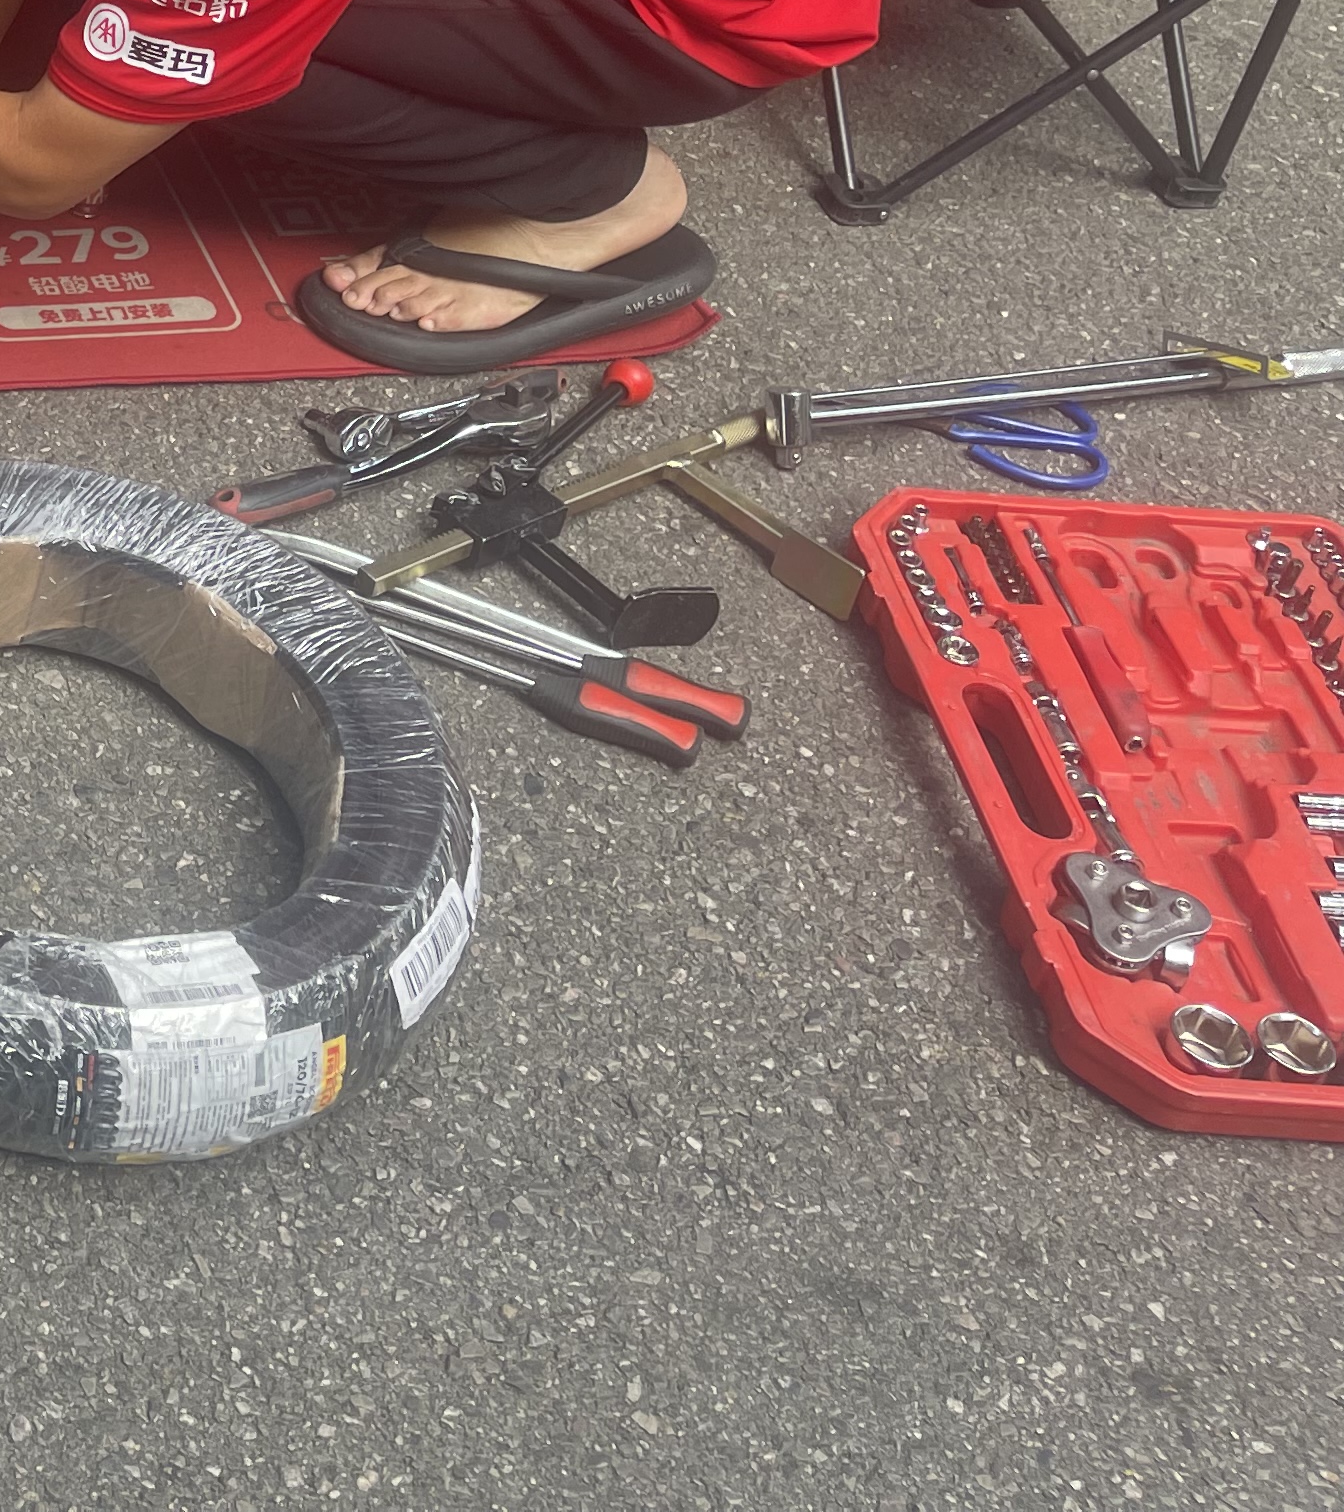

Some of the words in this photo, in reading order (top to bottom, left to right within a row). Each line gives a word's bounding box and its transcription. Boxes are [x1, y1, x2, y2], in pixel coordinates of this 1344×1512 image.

[127, 35, 209, 79] 爱玛
[27, 271, 156, 298] 铅酸电池
[624, 283, 695, 315] AWESOME
[37, 301, 176, 326] 免费上门安装
